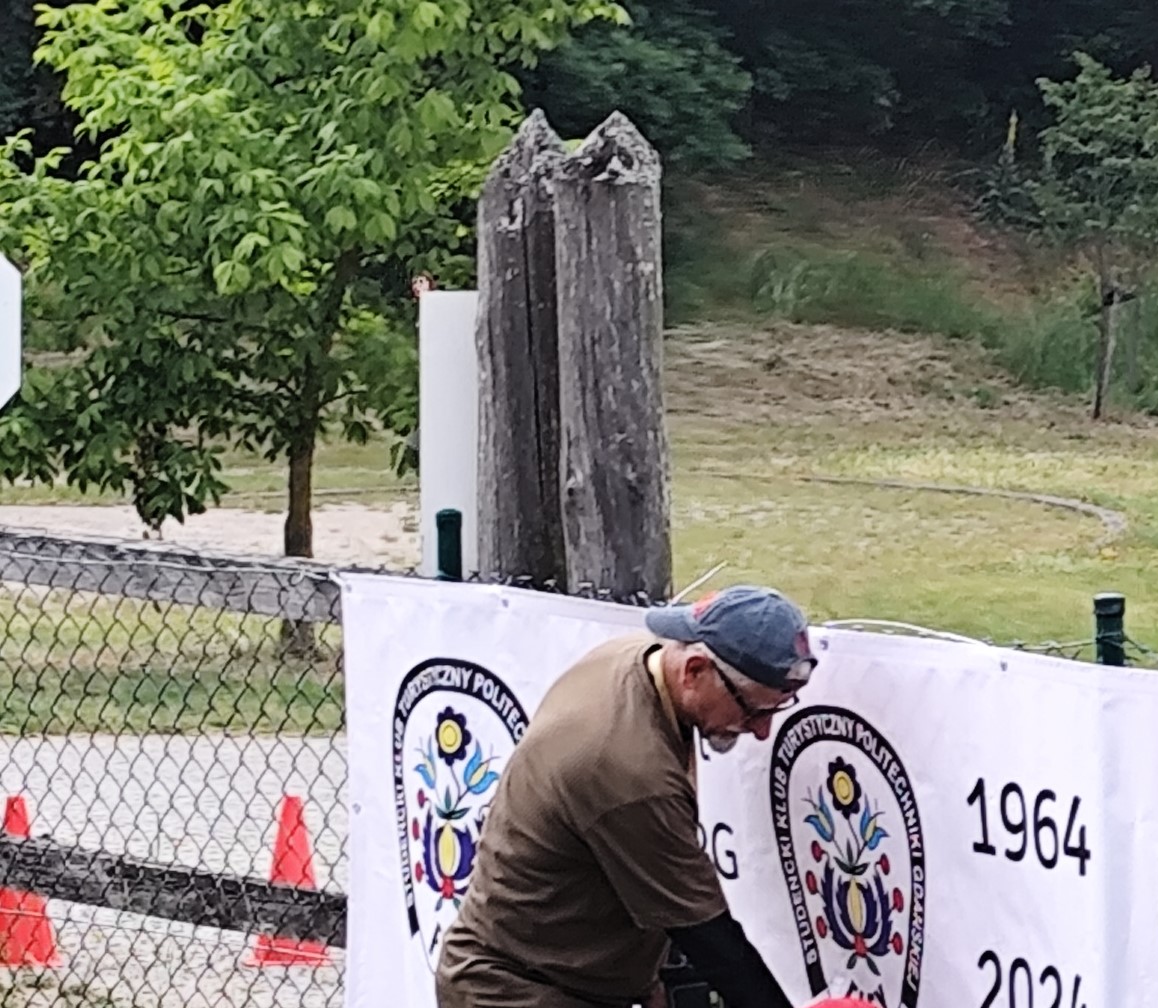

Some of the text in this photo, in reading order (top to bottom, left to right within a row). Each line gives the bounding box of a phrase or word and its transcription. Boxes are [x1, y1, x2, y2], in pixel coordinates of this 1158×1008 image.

[472, 672, 527, 741] POLITEC
[774, 769, 789, 831] KLUB
[855, 723, 922, 851] POLITECHNIKI
[966, 777, 1091, 877] 1964
[777, 835, 817, 965] STUDENCKI
